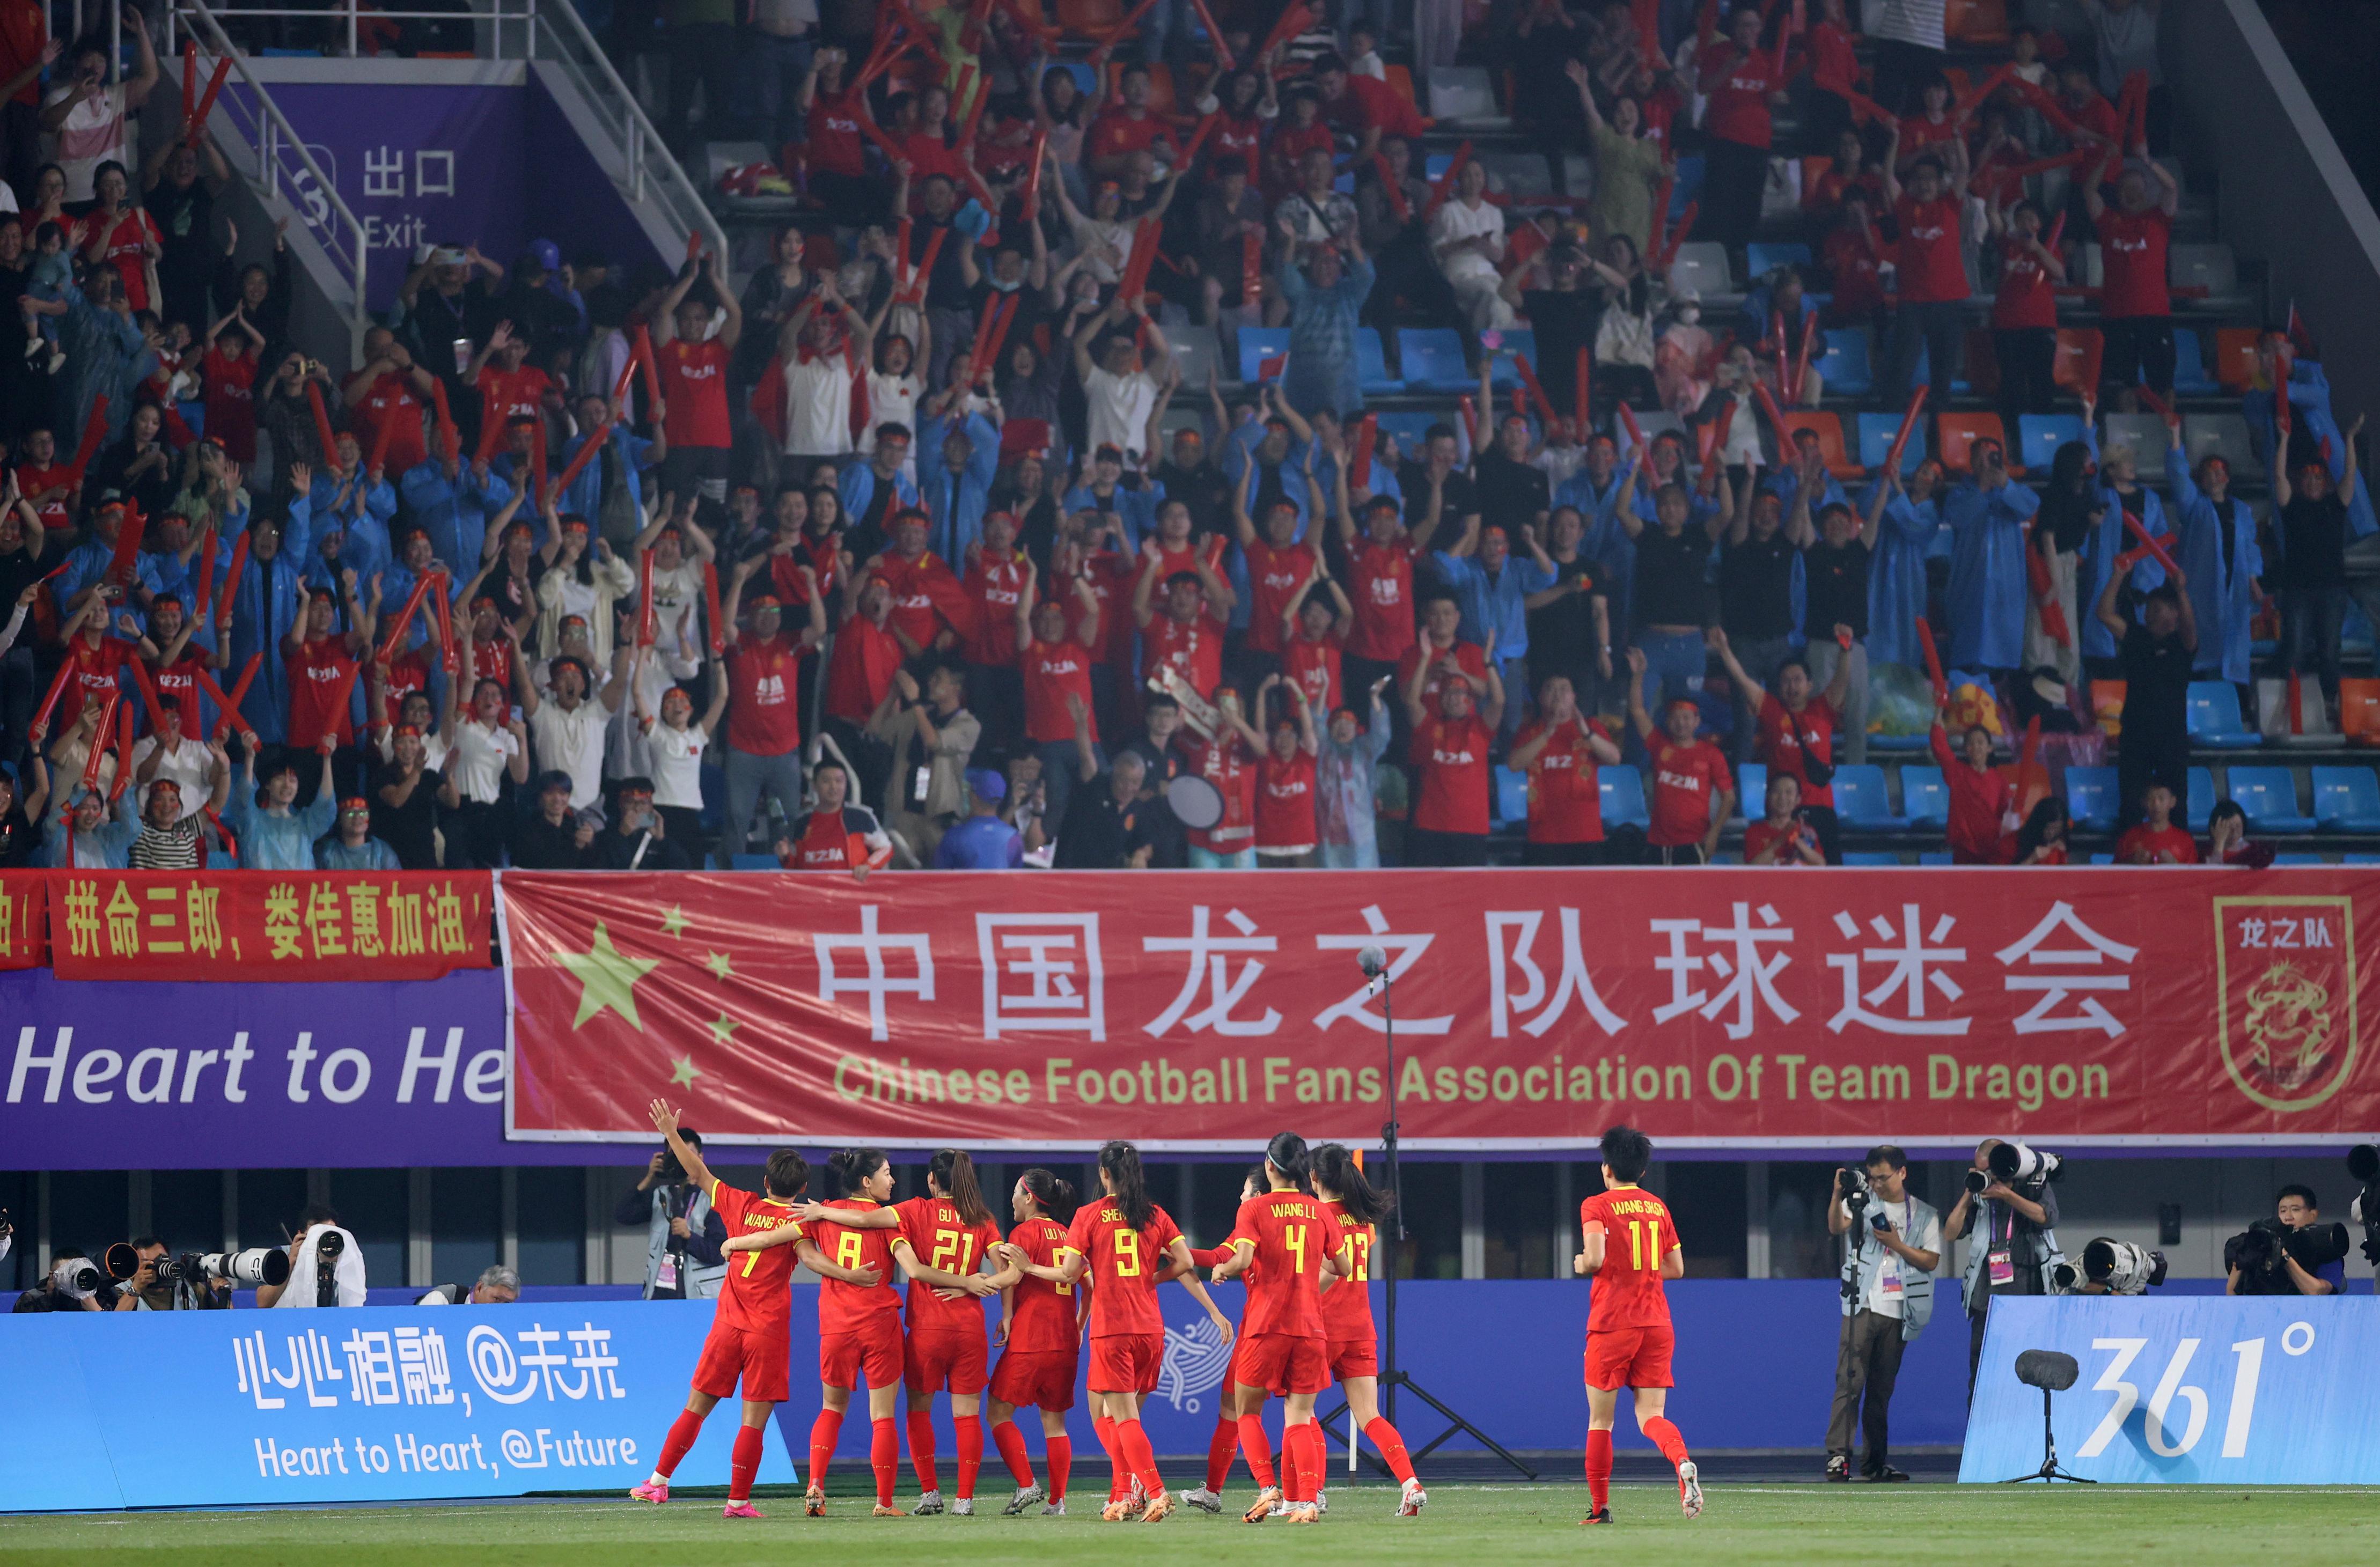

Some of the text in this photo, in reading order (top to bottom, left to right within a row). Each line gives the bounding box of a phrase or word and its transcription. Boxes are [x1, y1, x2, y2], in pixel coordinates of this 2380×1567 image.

[364, 145, 455, 197] 出口
[364, 215, 427, 248] Exit
[2238, 917, 2334, 948] 龙之队
[812, 900, 2139, 1042] 中国龙之队球迷会
[6, 1026, 254, 1103] Heart
[286, 1032, 372, 1103] to
[834, 1054, 2110, 1111] Chinese Football Fans Association Of Team Dragon
[744, 1211, 775, 1229] WANG
[939, 1208, 951, 1222] GU
[1270, 1203, 1317, 1219] WANG LL
[1611, 1200, 1644, 1216] WANG
[931, 1228, 974, 1277] 21
[1044, 1227, 1057, 1240] LIU
[1114, 1228, 1141, 1277] 9
[1286, 1225, 1306, 1274] 4
[1344, 1232, 1368, 1282] 13
[1628, 1220, 1659, 1271] 11
[254, 1437, 349, 1477] Heart
[355, 1437, 390, 1474] to
